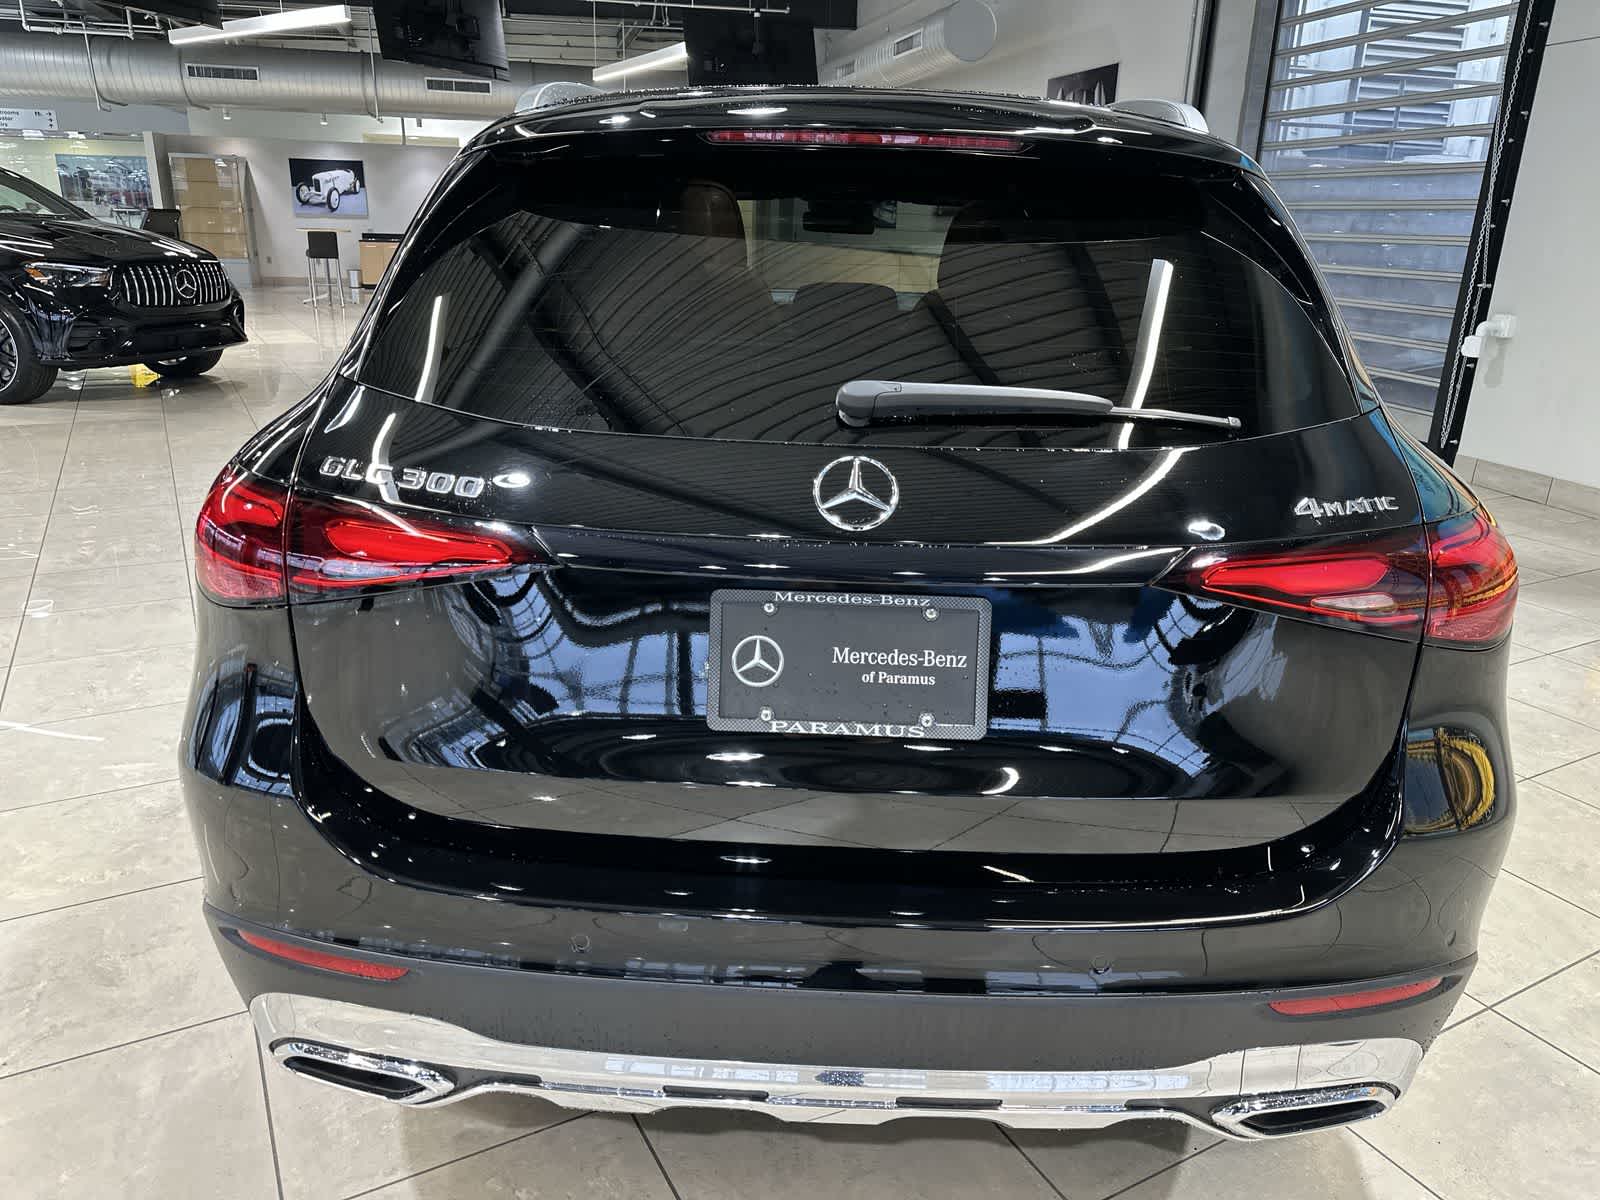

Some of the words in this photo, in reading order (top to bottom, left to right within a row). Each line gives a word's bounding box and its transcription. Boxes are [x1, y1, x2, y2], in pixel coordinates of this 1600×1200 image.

[319, 455, 393, 484] GLC
[397, 468, 485, 499] 300
[1294, 496, 1399, 518] 4MATIC
[774, 591, 931, 607] Mercedes-Benz
[832, 646, 967, 668] Mercedes-Benz
[862, 671, 875, 684] of
[878, 671, 936, 685] Paramus
[769, 720, 925, 738] PARAMUS
